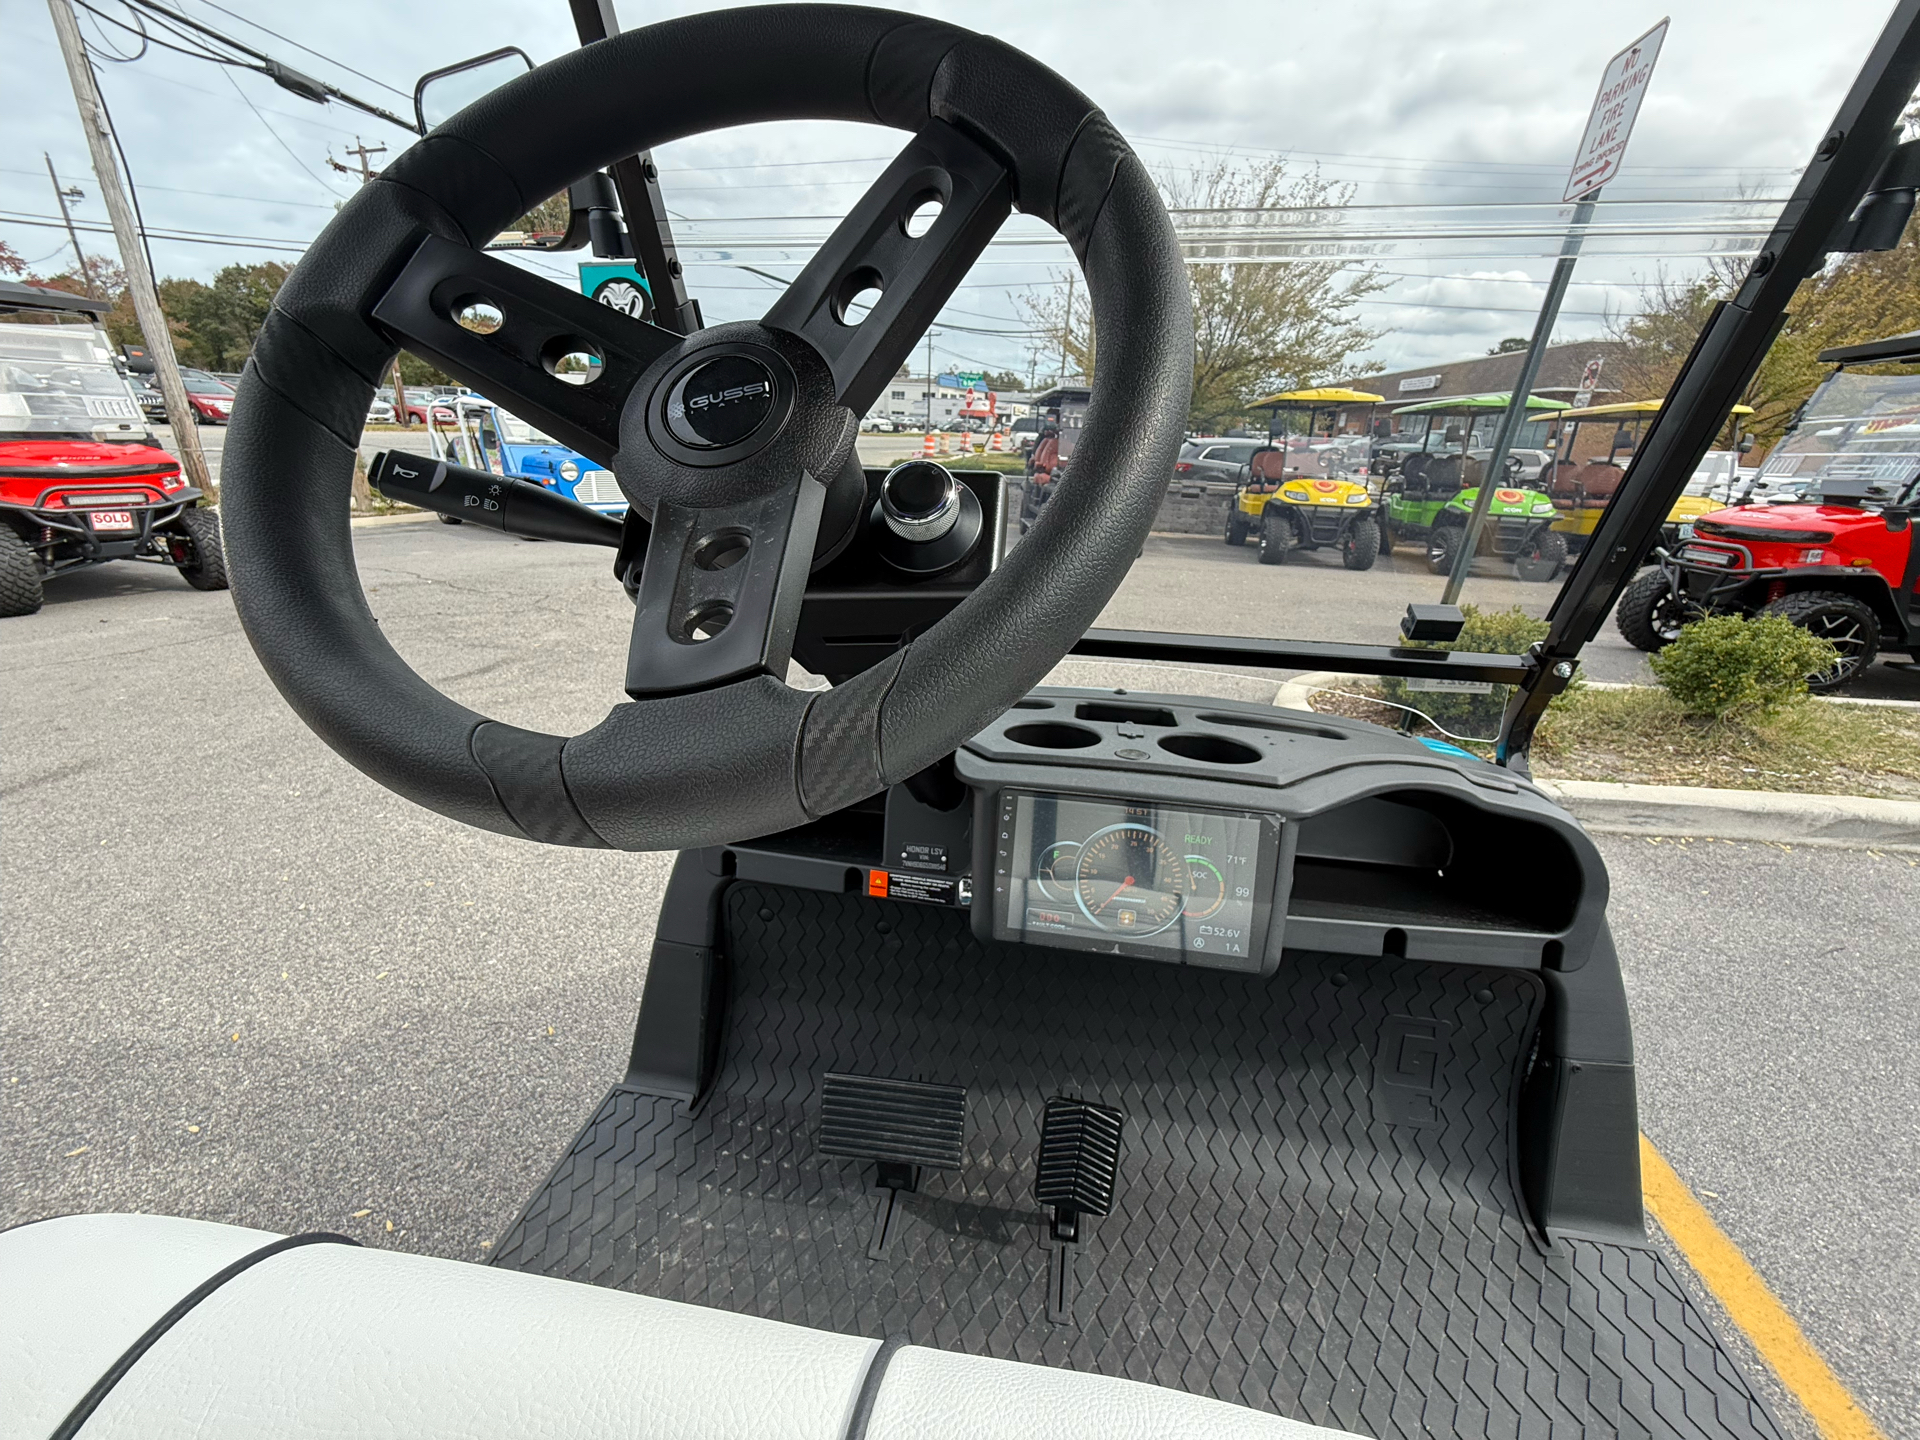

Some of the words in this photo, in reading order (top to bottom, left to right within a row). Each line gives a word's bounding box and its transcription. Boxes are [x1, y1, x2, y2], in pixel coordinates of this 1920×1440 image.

[1621, 48, 1642, 76] NO
[1598, 63, 1649, 111] PARKING
[1599, 97, 1629, 130] FIRE
[1589, 121, 1622, 155] LANE
[689, 381, 770, 409] GUSSI
[94, 514, 130, 524] SOLD
[1184, 833, 1213, 846] READY
[906, 845, 929, 854] HONOR
[1053, 850, 1060, 859] F
[1192, 871, 1208, 879] SOC
[1235, 886, 1250, 898] 99
[1213, 927, 1240, 938] 52.6V
